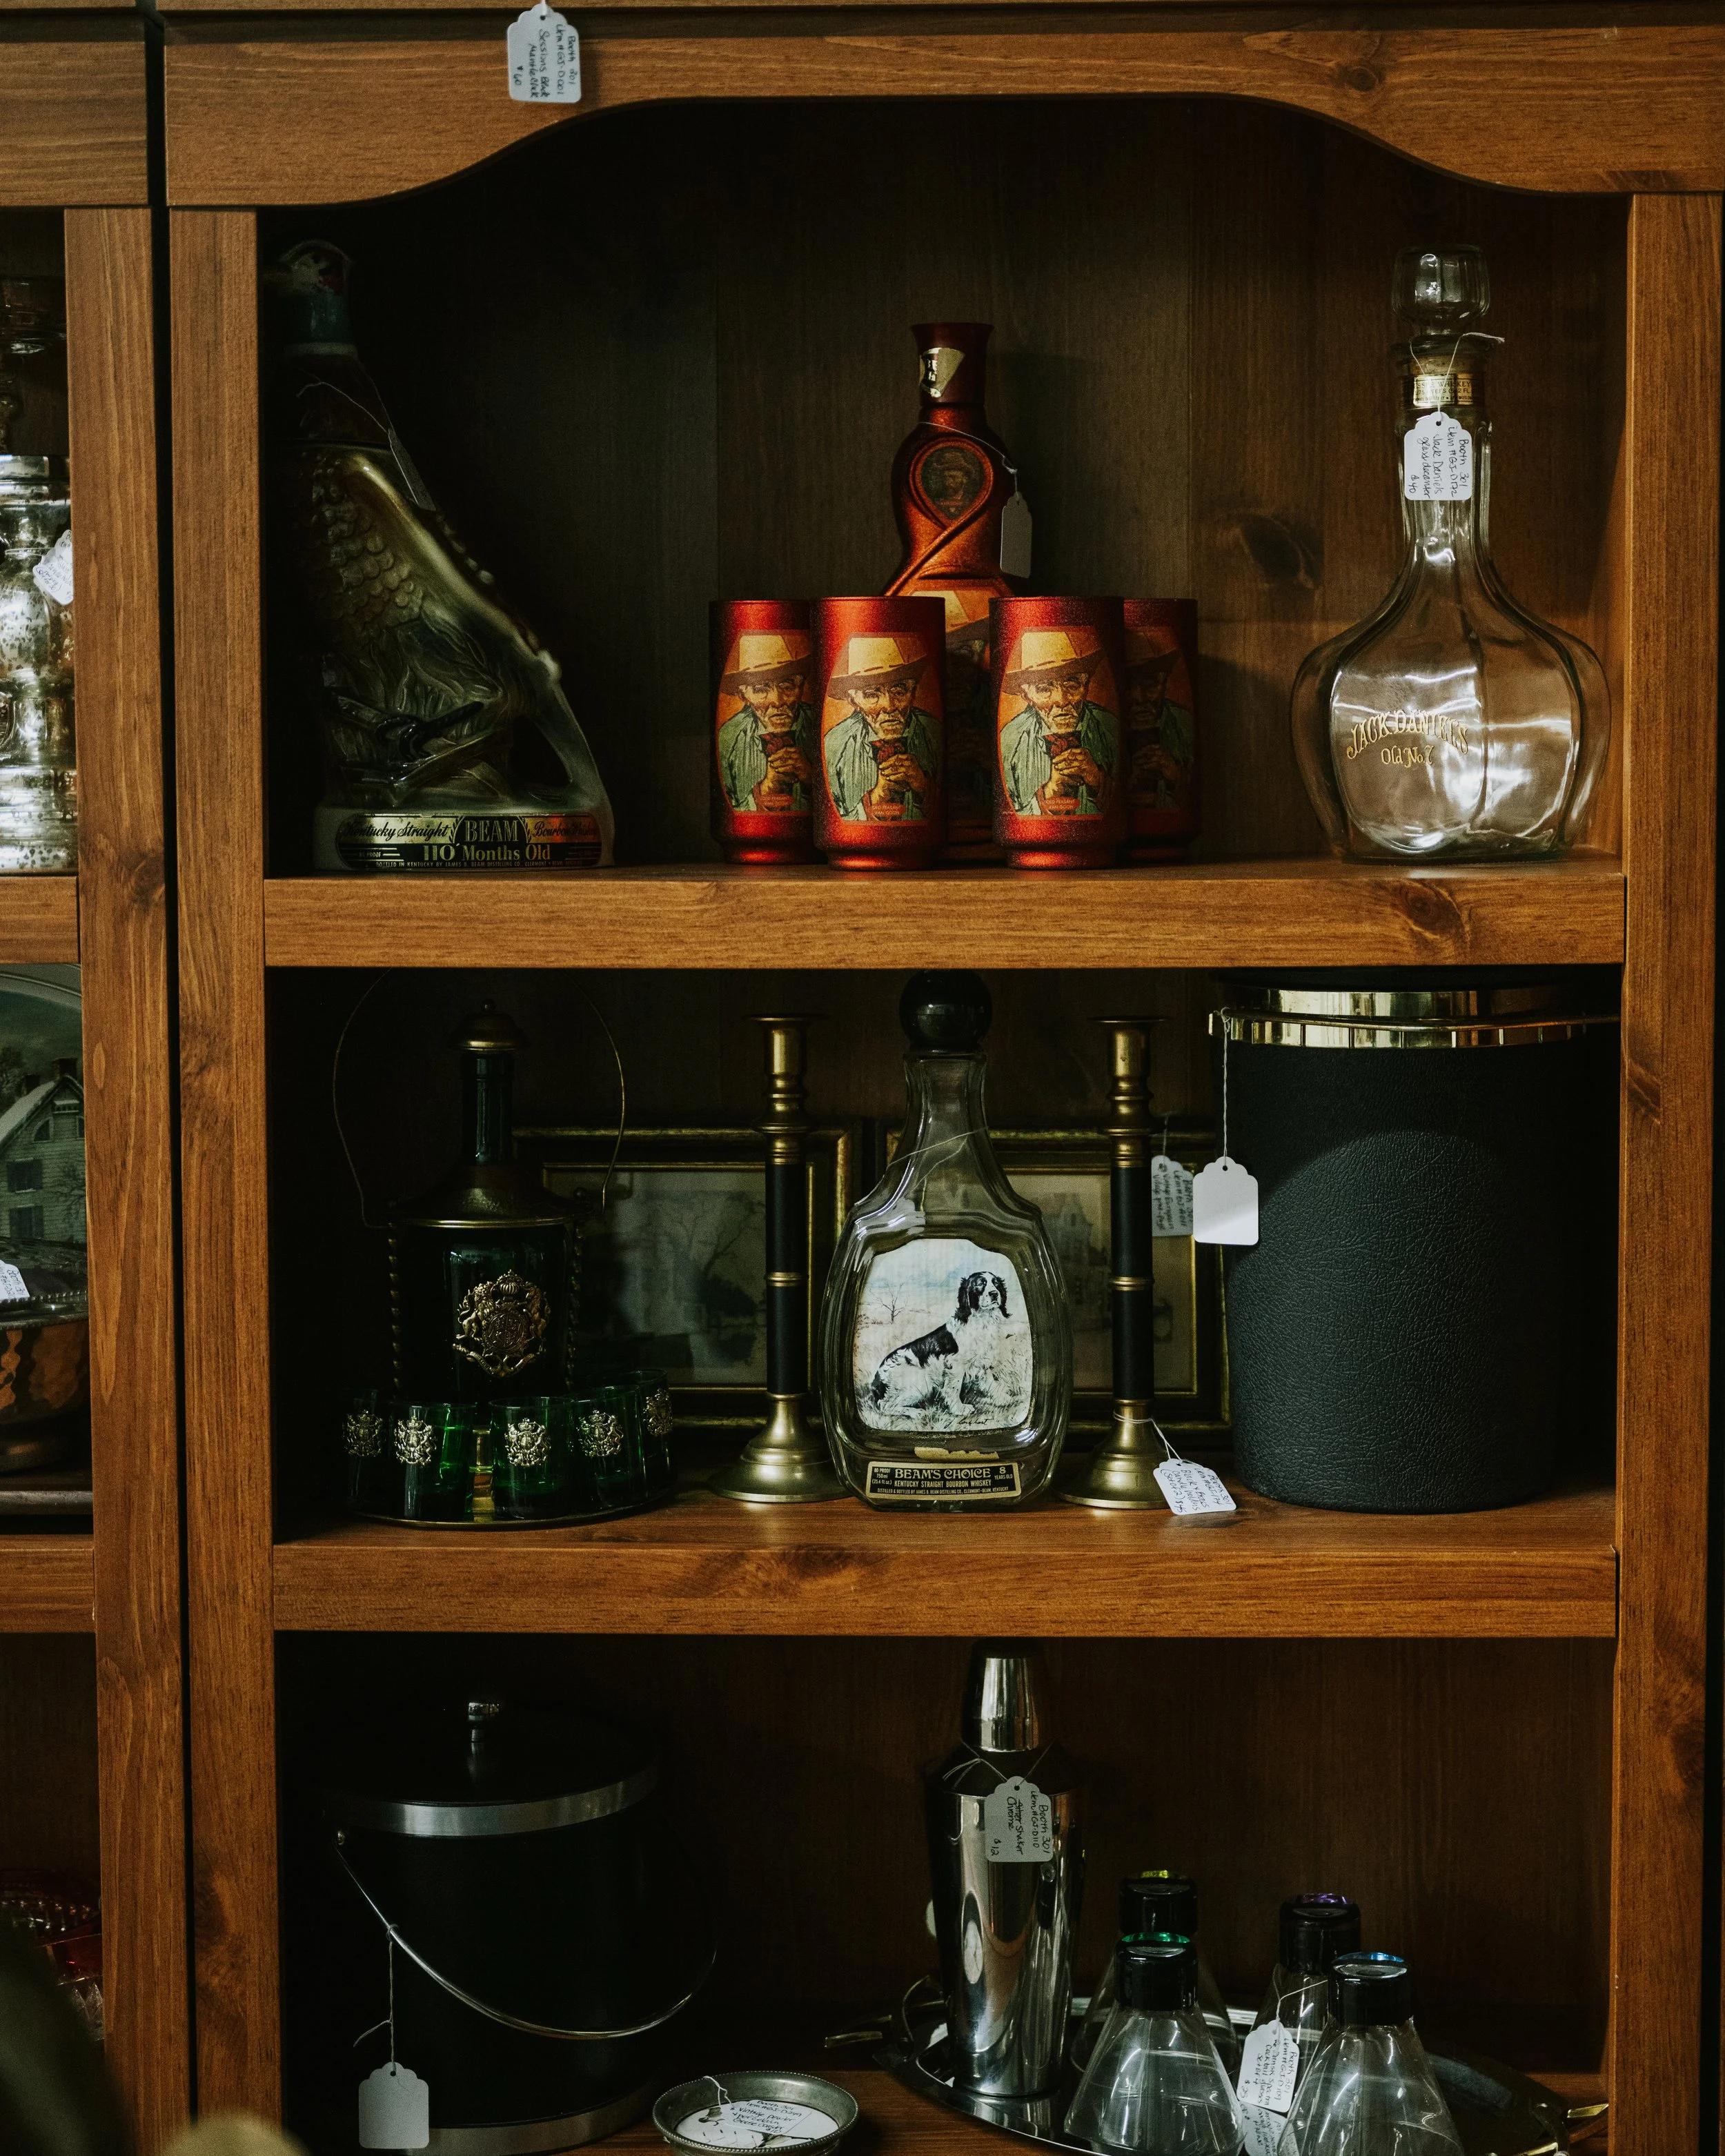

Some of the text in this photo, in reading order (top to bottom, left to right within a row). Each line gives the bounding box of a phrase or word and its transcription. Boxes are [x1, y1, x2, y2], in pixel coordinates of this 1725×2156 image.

[1432, 435, 1443, 494] Jack Daniels
[1459, 439, 1468, 486] Booth 301
[1422, 462, 1431, 498] decanter
[1346, 712, 1392, 760] JACK
[1381, 745, 1403, 764] Old
[397, 821, 452, 841] Straight
[463, 820, 519, 842] BEAM
[423, 844, 551, 861] 110 Months Old
[895, 1468, 991, 1479] BEAM'S CHOICE
[1007, 1797, 1016, 1830] Chrome
[1039, 1805, 1048, 1832] Booth
[739, 2108, 765, 2117] Vintage
